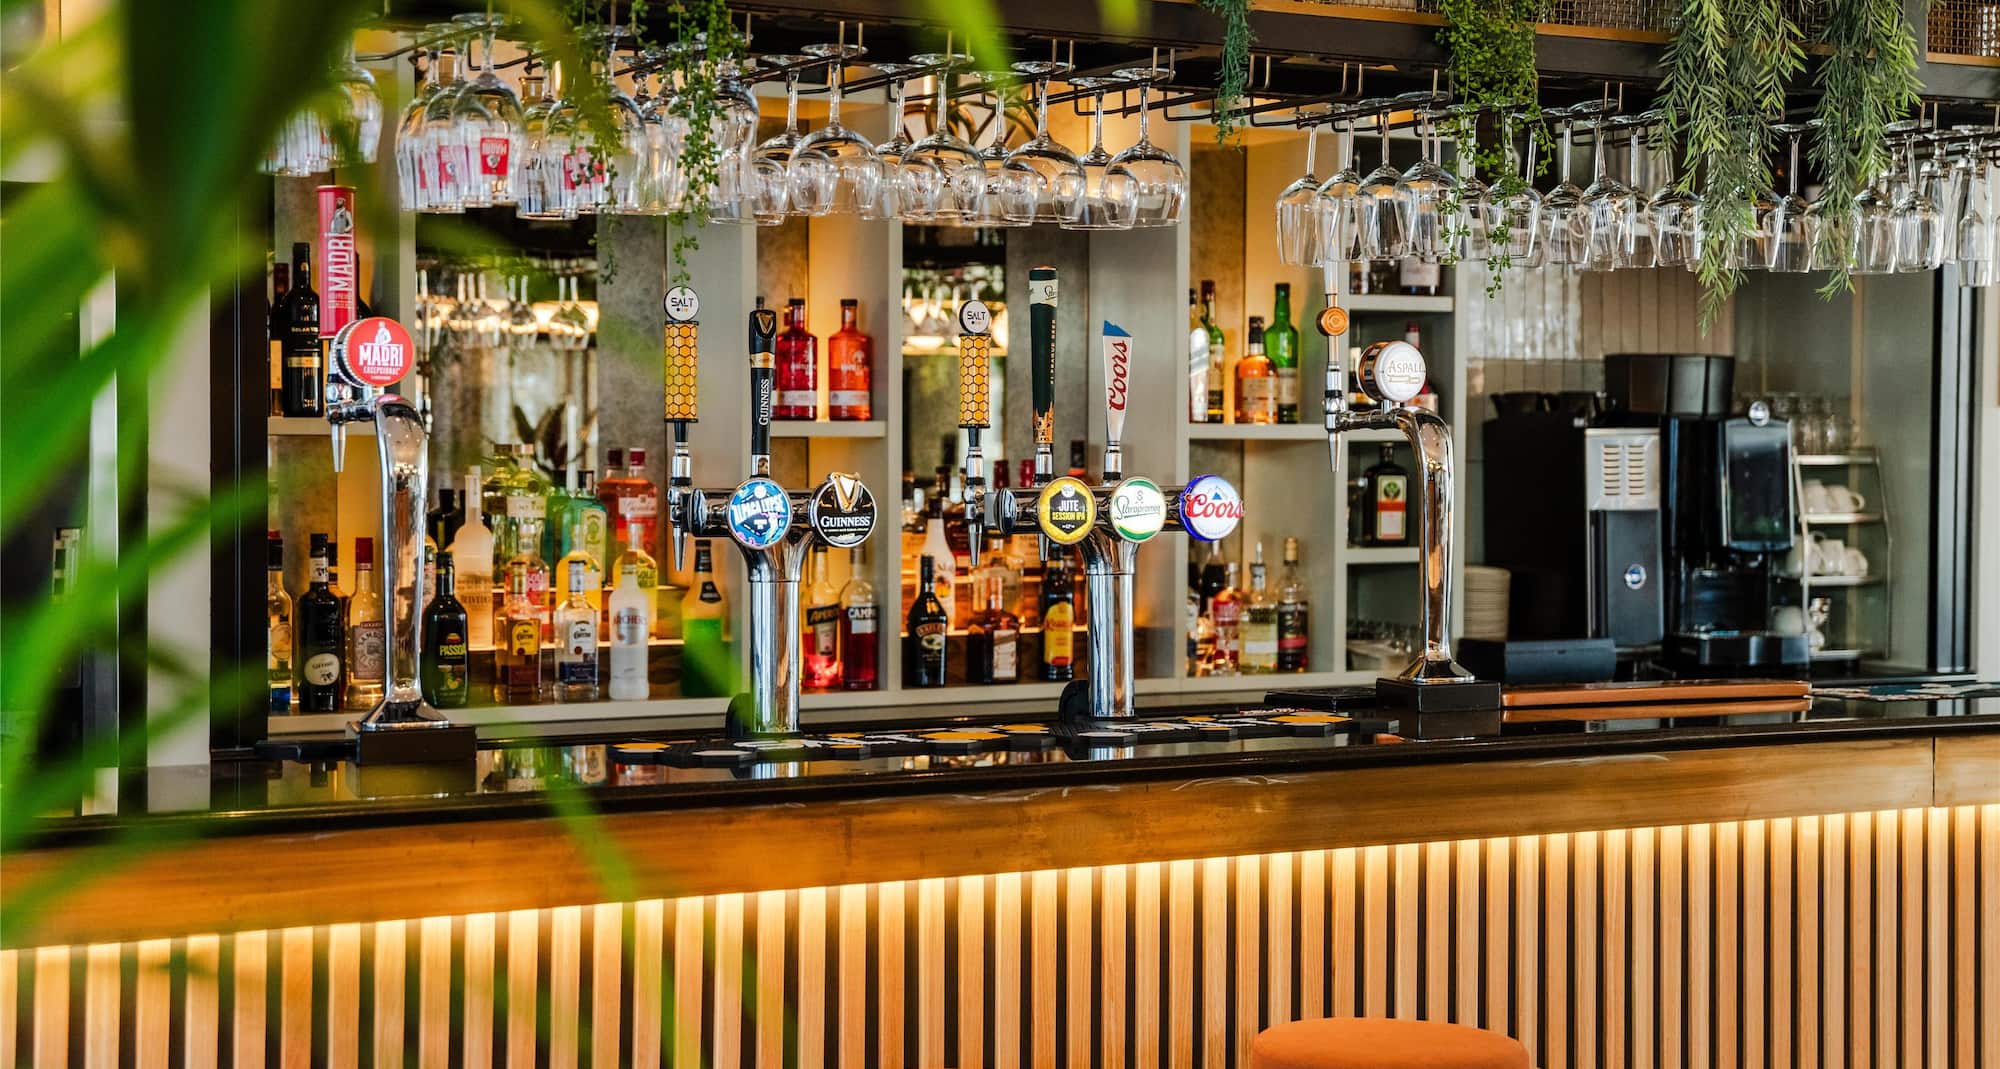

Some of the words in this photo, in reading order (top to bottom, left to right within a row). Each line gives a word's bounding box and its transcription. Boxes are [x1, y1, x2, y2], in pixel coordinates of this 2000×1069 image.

[327, 232, 353, 292] MADRI
[671, 297, 694, 308] SALT
[967, 311, 986, 321] SALT
[358, 343, 403, 367] MADRI
[1388, 360, 1423, 373] ASPALL
[1108, 340, 1128, 412] Coors
[758, 378, 770, 426] GUINNESS
[1058, 499, 1080, 512] JUTE
[1185, 493, 1244, 519] Coors
[820, 515, 871, 528] GUINNESS
[1052, 511, 1076, 521] SESSION
